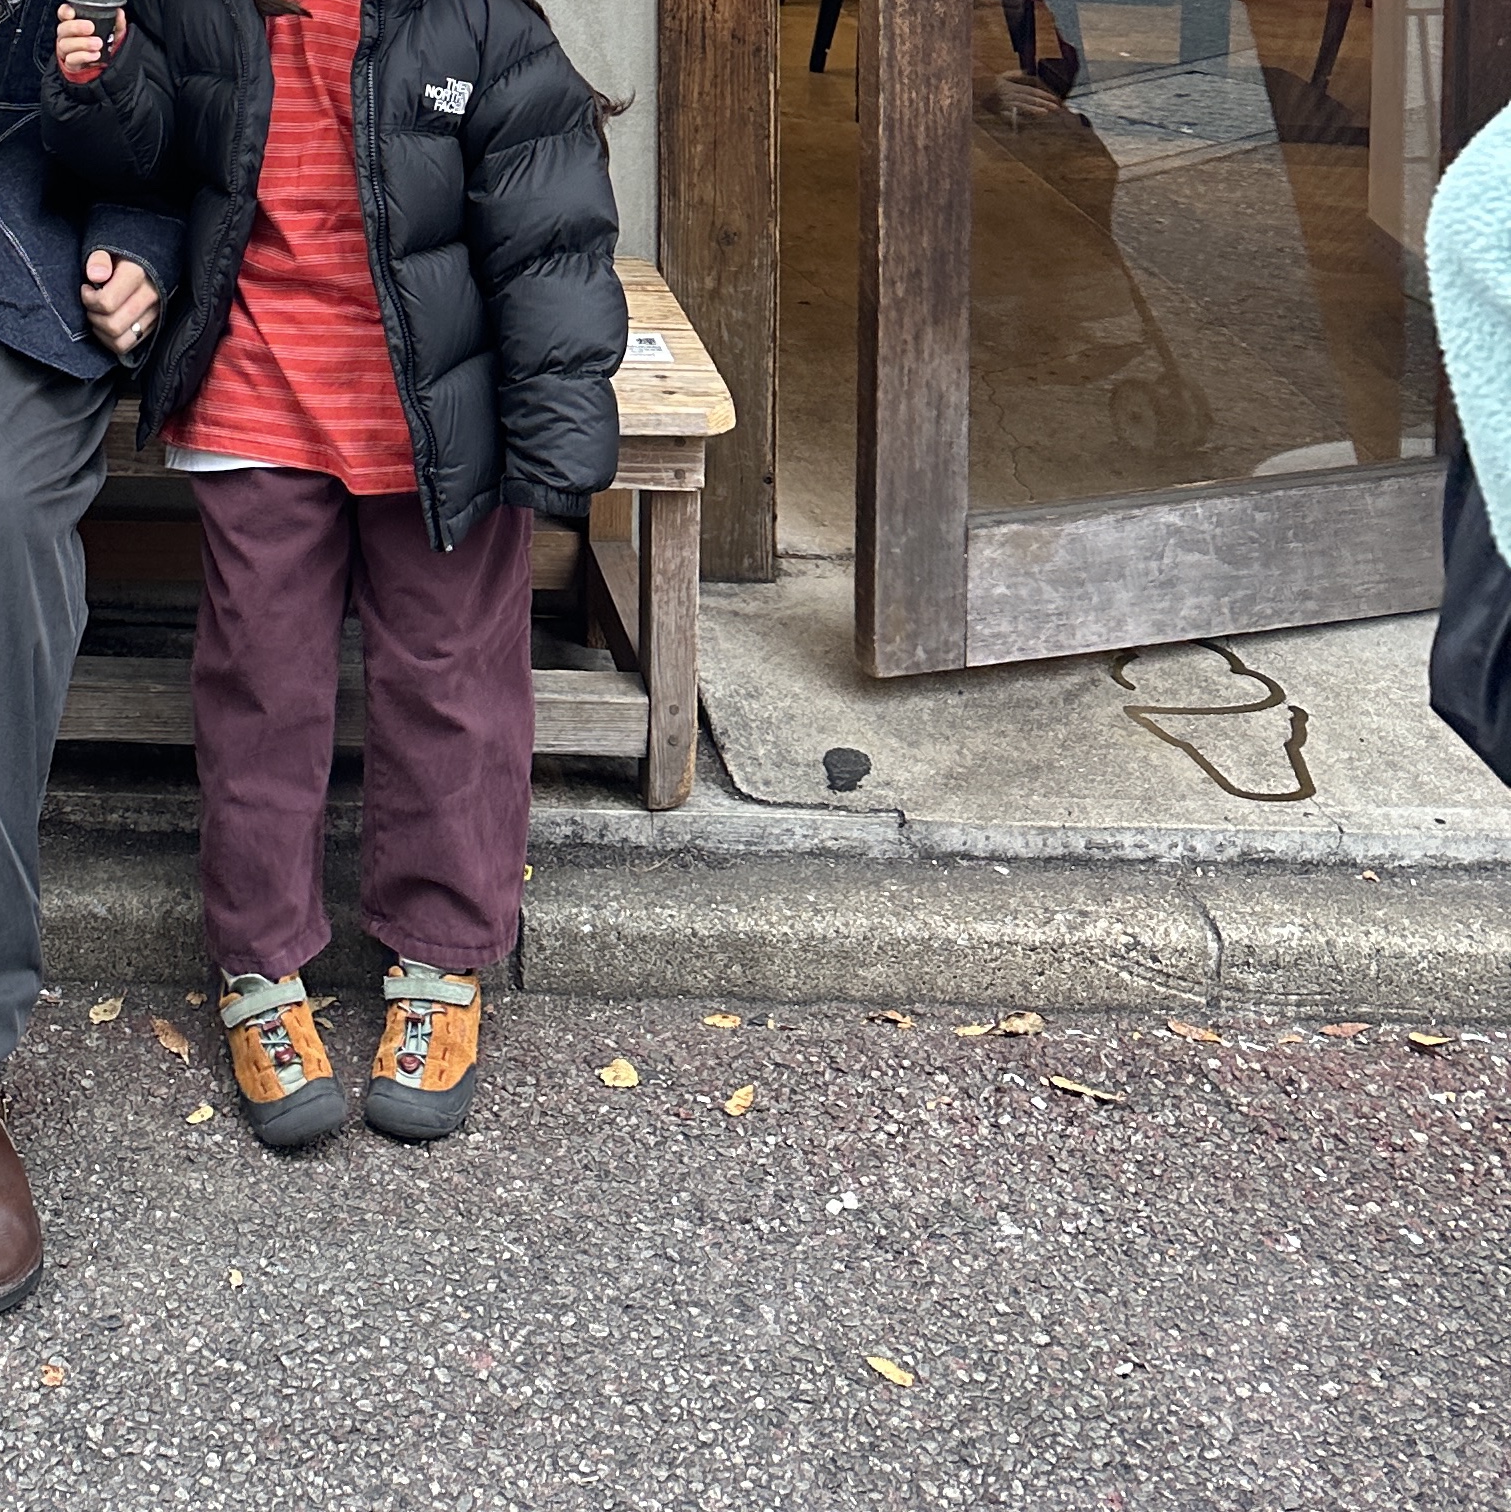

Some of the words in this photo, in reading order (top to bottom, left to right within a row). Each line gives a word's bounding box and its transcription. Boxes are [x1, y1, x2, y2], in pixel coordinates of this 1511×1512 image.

[425, 83, 465, 103] NORTH
[446, 77, 468, 93] THE
[433, 99, 462, 115] FACE
